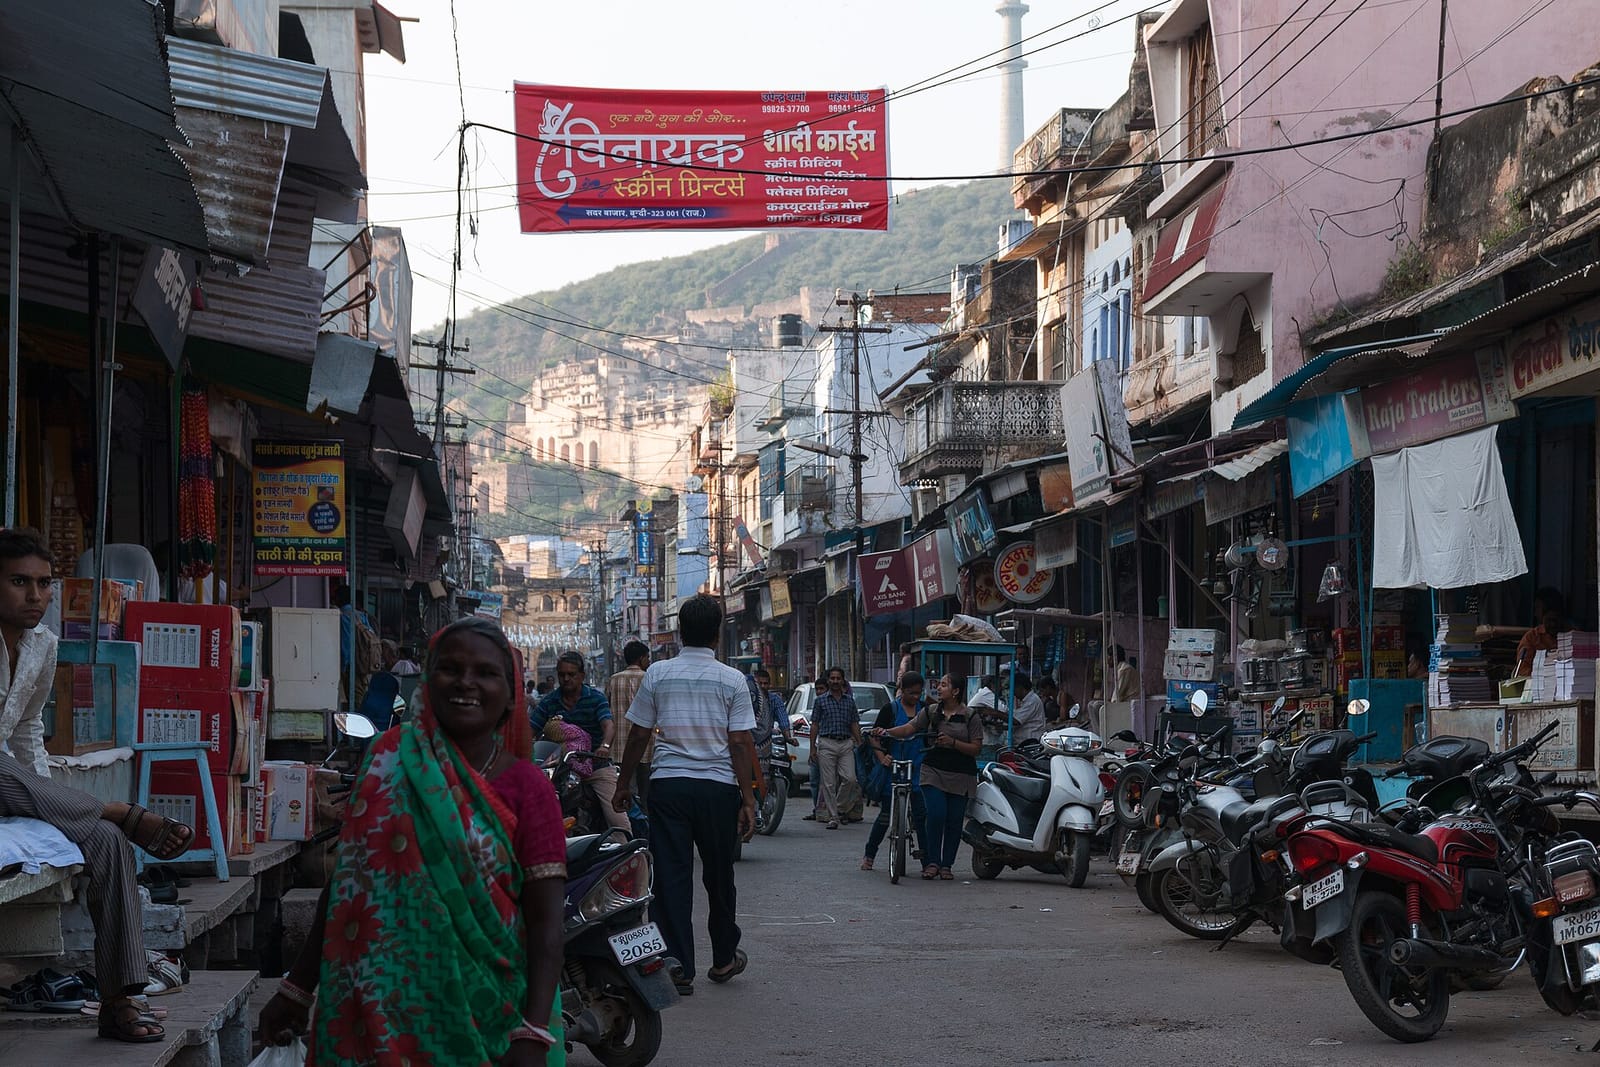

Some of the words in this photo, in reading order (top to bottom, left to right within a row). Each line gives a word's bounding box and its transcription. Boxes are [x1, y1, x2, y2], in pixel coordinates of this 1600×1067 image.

[541, 117, 746, 169] विनायक
[763, 121, 812, 153] शादी
[613, 169, 673, 198] स्क्रीन
[679, 169, 746, 198] प्रिन्टर्स
[1367, 396, 1405, 433] Raja
[1407, 376, 1479, 419] Traders
[256, 546, 281, 561] लाठी
[283, 546, 296, 561] जी
[297, 547, 313, 561] की
[314, 550, 343, 566] दुकान
[873, 593, 887, 601] AXIS
[889, 590, 907, 599] BANK
[210, 627, 221, 669] VENUS
[211, 712, 221, 753] VENUS
[620, 938, 662, 963] 2085
